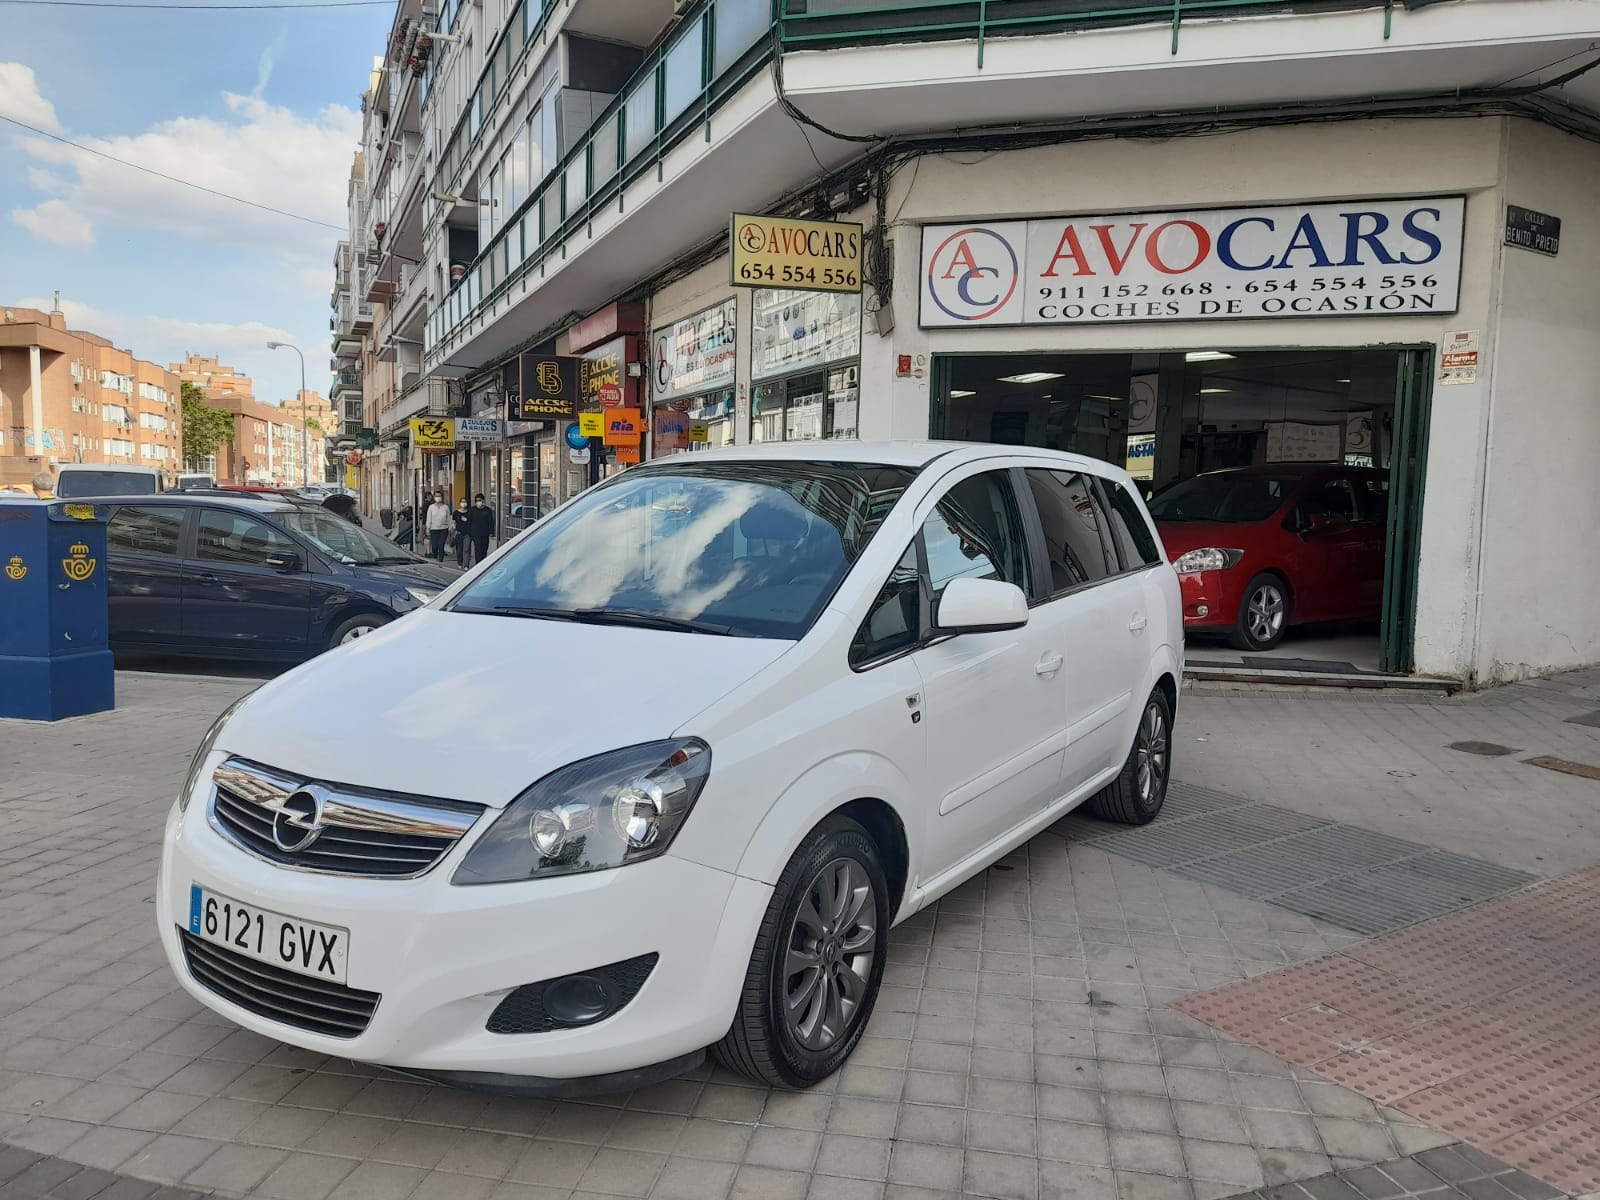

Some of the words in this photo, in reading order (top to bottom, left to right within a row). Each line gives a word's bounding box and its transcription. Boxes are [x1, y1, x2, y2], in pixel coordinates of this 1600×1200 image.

[1524, 212, 1545, 226] CALLE
[767, 226, 857, 260] AVOCARS
[1040, 207, 1442, 277] AVOCARS
[1506, 226, 1531, 246] BENITO
[1535, 233, 1559, 252] PRIETO
[741, 262, 775, 281] 654
[782, 265, 816, 284] 554
[823, 268, 857, 287] 556
[1039, 286, 1086, 299] 911
[1101, 284, 1149, 298] 152
[1161, 281, 1213, 296] 668
[1245, 279, 1298, 293] 654
[1311, 276, 1367, 290] 554
[1380, 274, 1438, 288] 556
[1038, 300, 1180, 319] COCHES
[1200, 299, 1242, 315] DE
[1261, 290, 1436, 313] OCASIÓN
[524, 405, 573, 414] PHONE
[611, 417, 634, 431] Ria
[414, 439, 430, 447] TALLER
[193, 915, 200, 926] E
[205, 898, 264, 953] 6121
[279, 922, 338, 975] GVX
